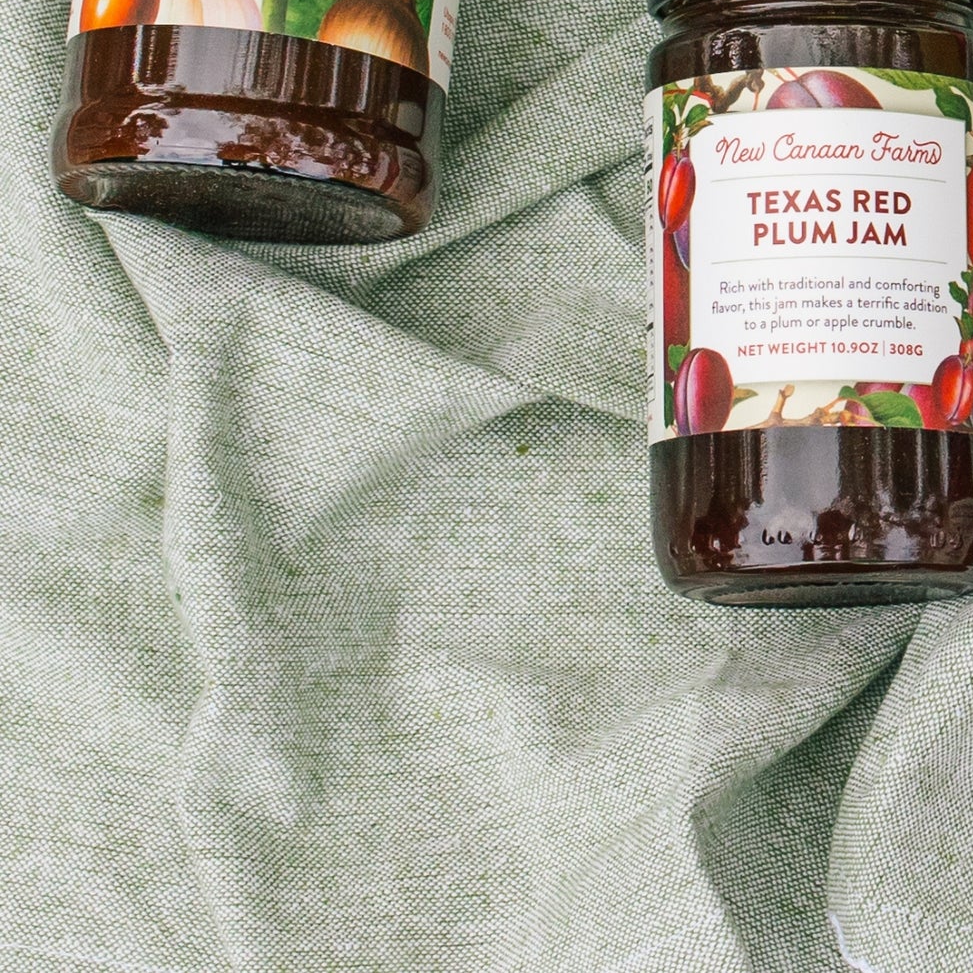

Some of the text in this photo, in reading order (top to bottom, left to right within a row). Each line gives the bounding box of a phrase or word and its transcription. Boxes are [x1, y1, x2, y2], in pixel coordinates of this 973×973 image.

[716, 131, 942, 165] New Canaan Farms
[747, 189, 911, 215] TEXAS RED
[754, 221, 907, 246] PLUM JAM
[720, 276, 940, 299] Rich with traditional and comforting
[712, 295, 948, 314] flavor, this jam makes a terrific addition
[744, 314, 916, 333] to a plum or apple crumble.
[738, 342, 923, 357] NET WEIGHT 10.9OZ 308G
